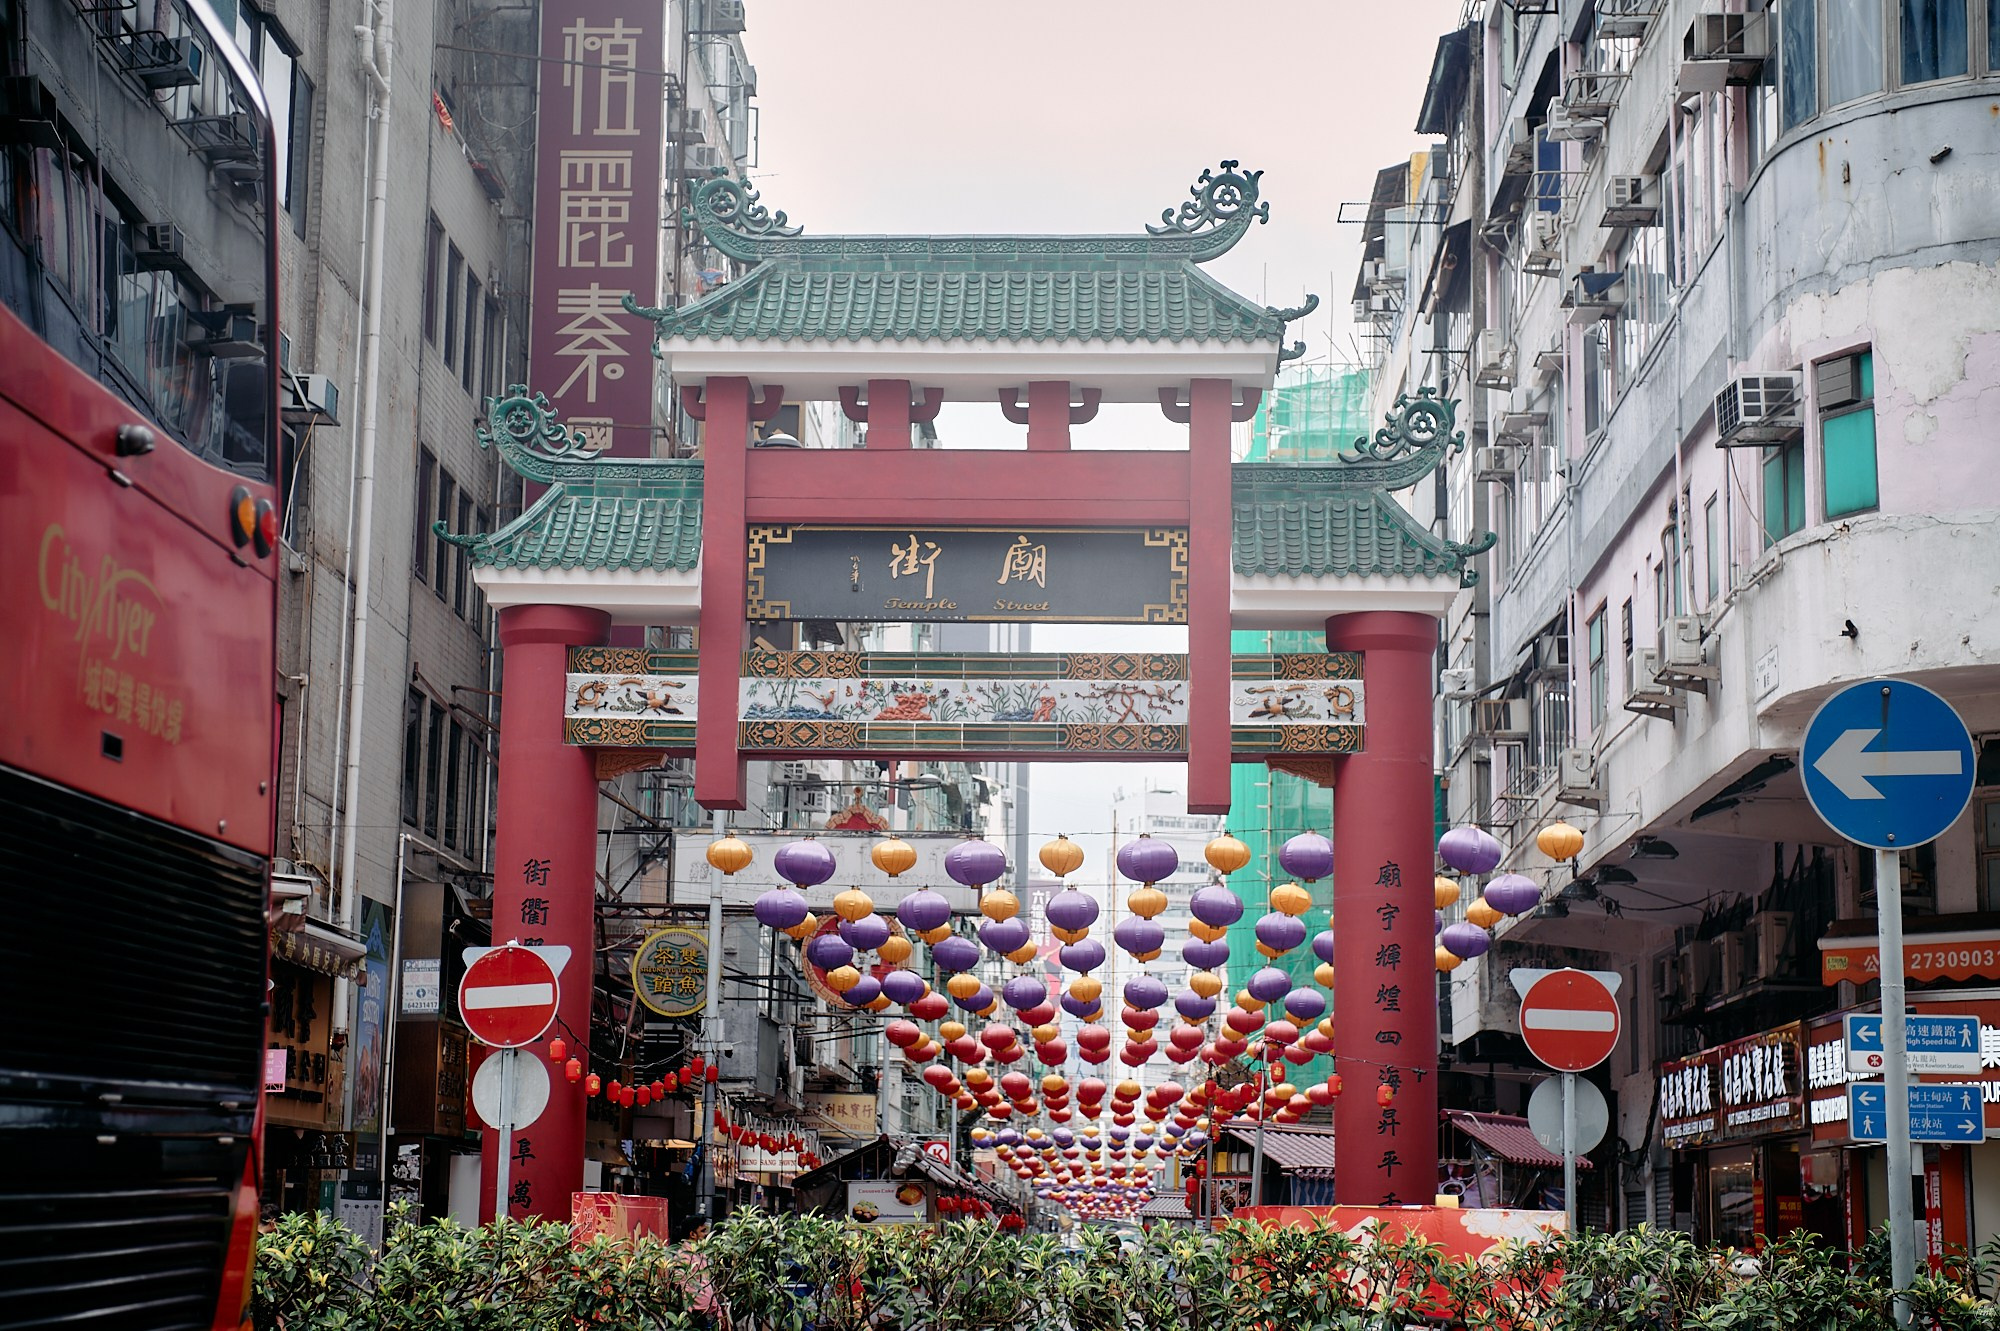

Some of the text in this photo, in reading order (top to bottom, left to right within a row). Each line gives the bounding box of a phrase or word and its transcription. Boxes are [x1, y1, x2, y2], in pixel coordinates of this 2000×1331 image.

[884, 598, 1050, 612] Temple Street
[1911, 949, 2000, 970] 2730903
[408, 1001, 438, 1009] 64231417
[1921, 1038, 1943, 1047] Speed
[1944, 1038, 1957, 1046] Rail
